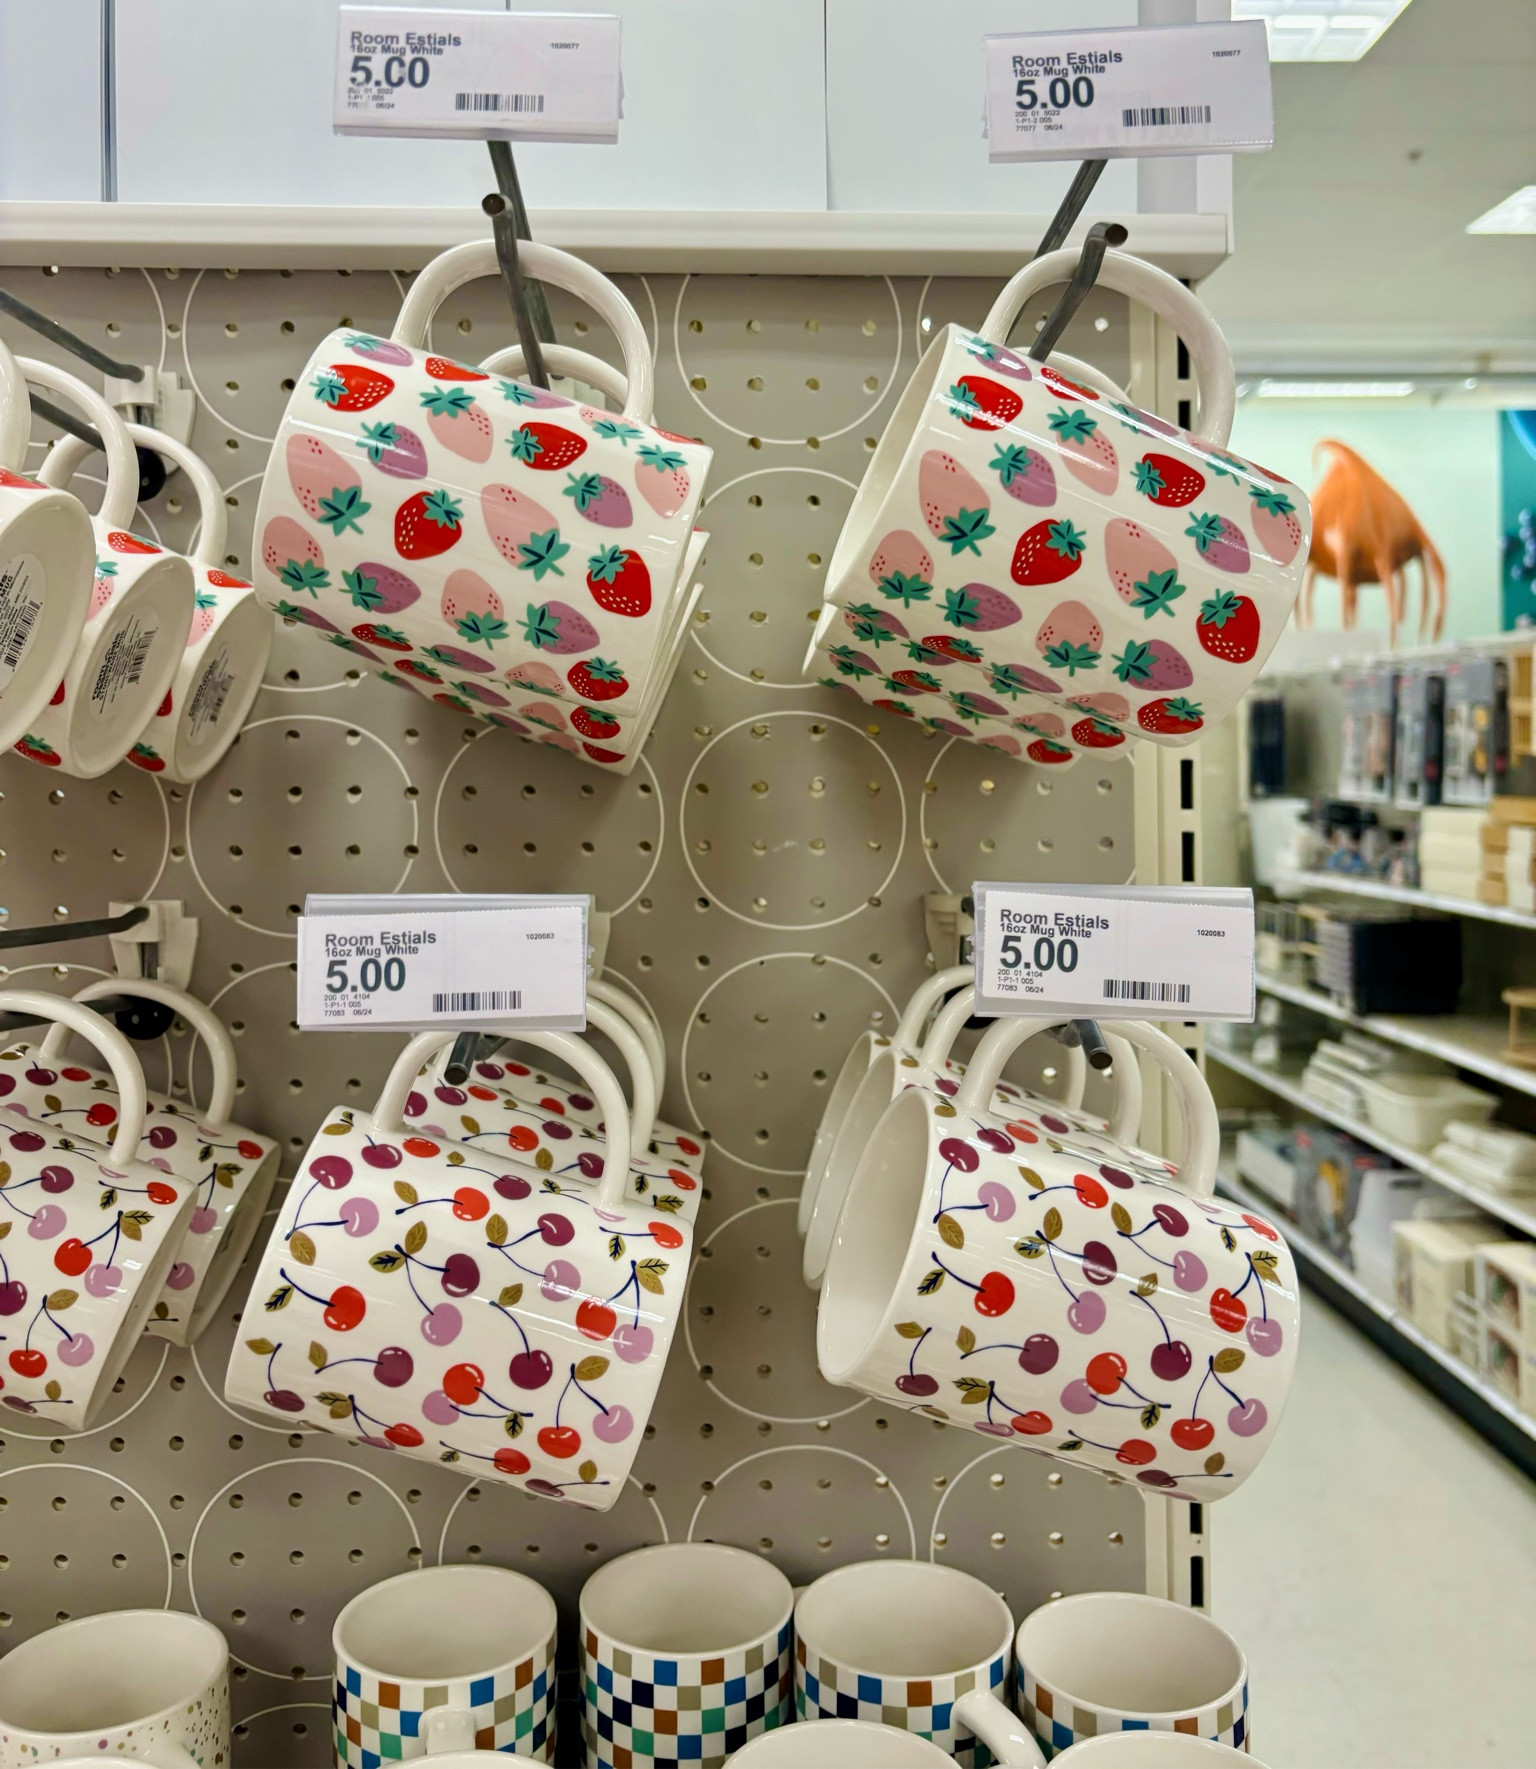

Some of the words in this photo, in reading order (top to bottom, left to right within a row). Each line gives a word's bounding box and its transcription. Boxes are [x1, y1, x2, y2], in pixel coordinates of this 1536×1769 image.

[350, 31, 400, 45] Room
[405, 32, 462, 46] Estials
[351, 44, 378, 54] 16oz
[381, 45, 407, 56] Mug
[410, 45, 444, 55] White
[1012, 55, 1061, 68] Room
[1066, 50, 1123, 66] Estials
[350, 55, 430, 88] 5.00
[1013, 67, 1040, 78] 16oz
[1043, 66, 1069, 78] Mug
[1072, 64, 1106, 75] White
[1015, 76, 1095, 110] 5.00
[0, 575, 13, 597] MUG
[1000, 909, 1048, 925] Room
[1054, 913, 1110, 930] Estials
[325, 933, 374, 947] Room
[380, 930, 437, 945] Estials
[1000, 922, 1027, 934] 16oz
[1030, 924, 1055, 938] Mug
[1058, 926, 1092, 938] White
[325, 947, 352, 957] 16oz
[355, 946, 382, 958] Mug
[385, 944, 419, 955] White
[1000, 935, 1079, 973] 5.00
[326, 957, 406, 993] 5.00
[997, 968, 1011, 976] 200
[1013, 969, 1022, 977] 01
[1026, 970, 1043, 978] 4104
[324, 993, 338, 1001] 200
[340, 993, 349, 1001] 01
